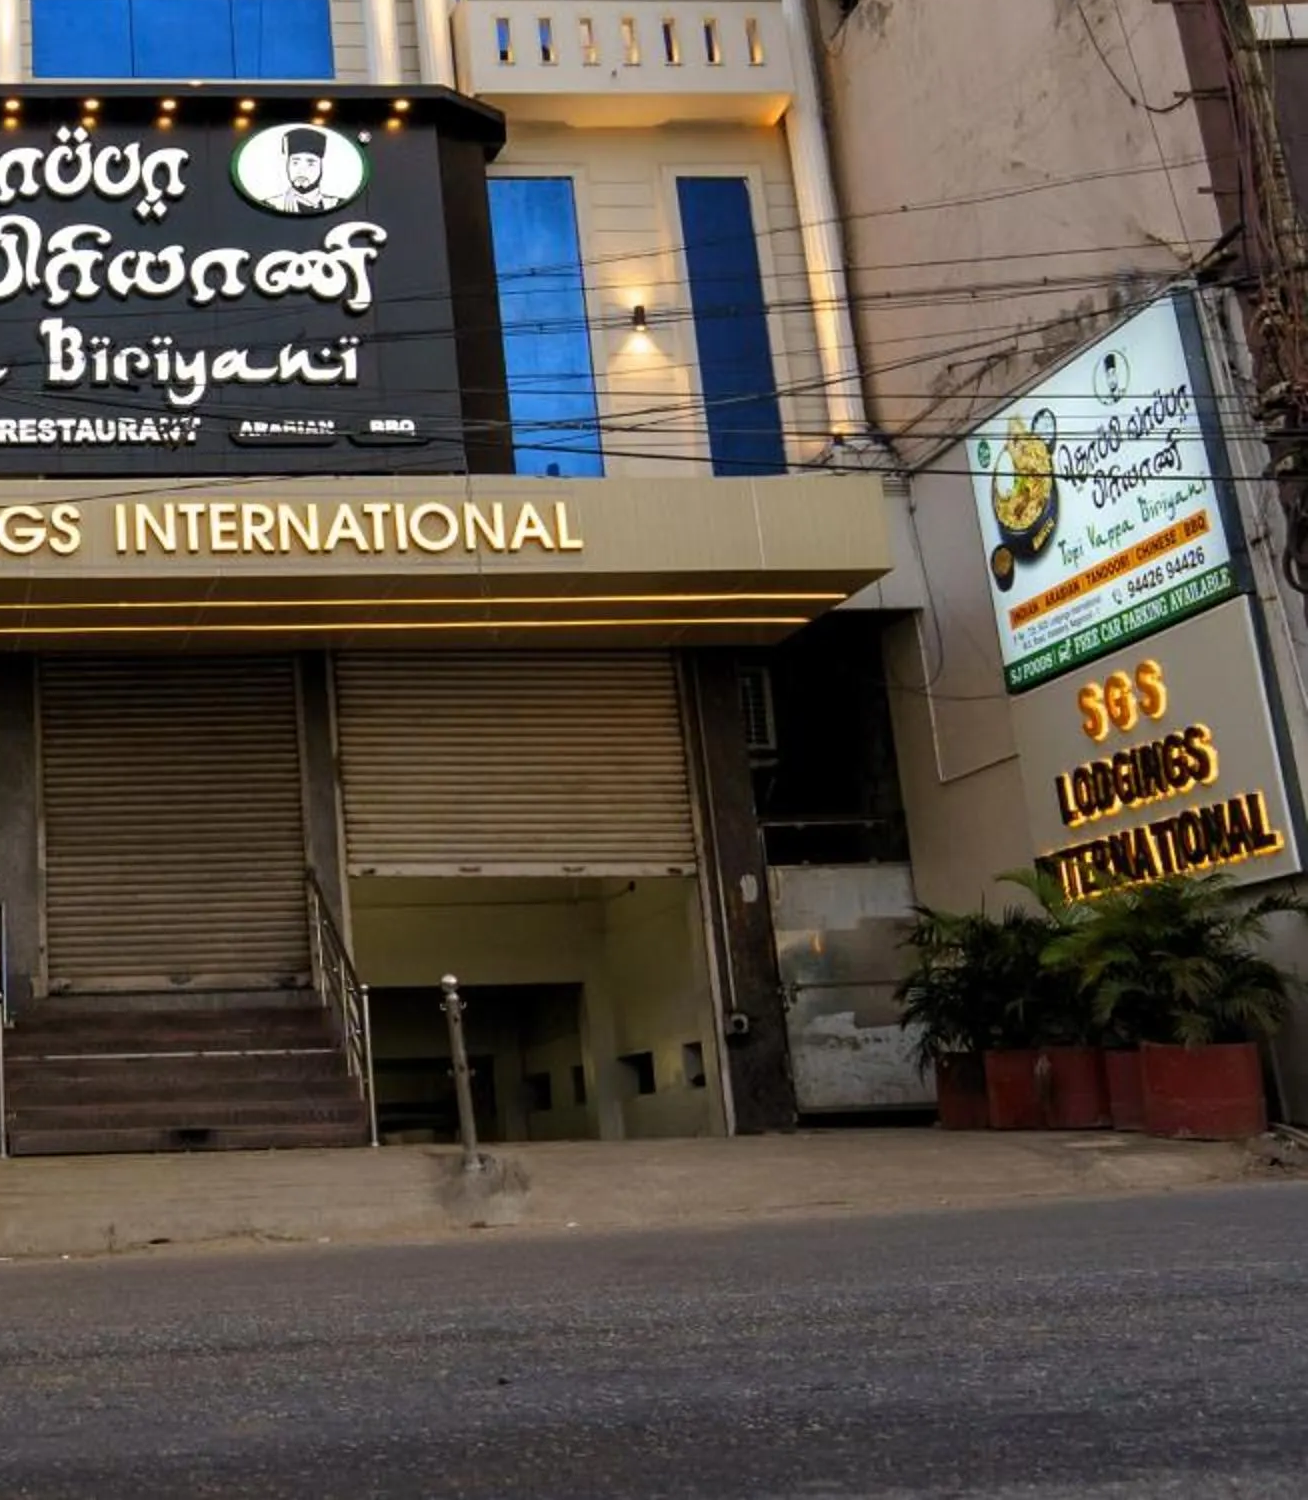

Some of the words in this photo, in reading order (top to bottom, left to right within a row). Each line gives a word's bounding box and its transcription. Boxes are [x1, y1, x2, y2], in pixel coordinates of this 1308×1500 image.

[115, 501, 585, 554] INTERNATIONAL
[1135, 528, 1178, 561] CHINESE
[1183, 515, 1206, 538] BBQ
[1126, 565, 1165, 598] 94426
[1165, 545, 1205, 579] 94426
[1078, 660, 1167, 741] SGS
[1055, 724, 1217, 828] LODGINGS
